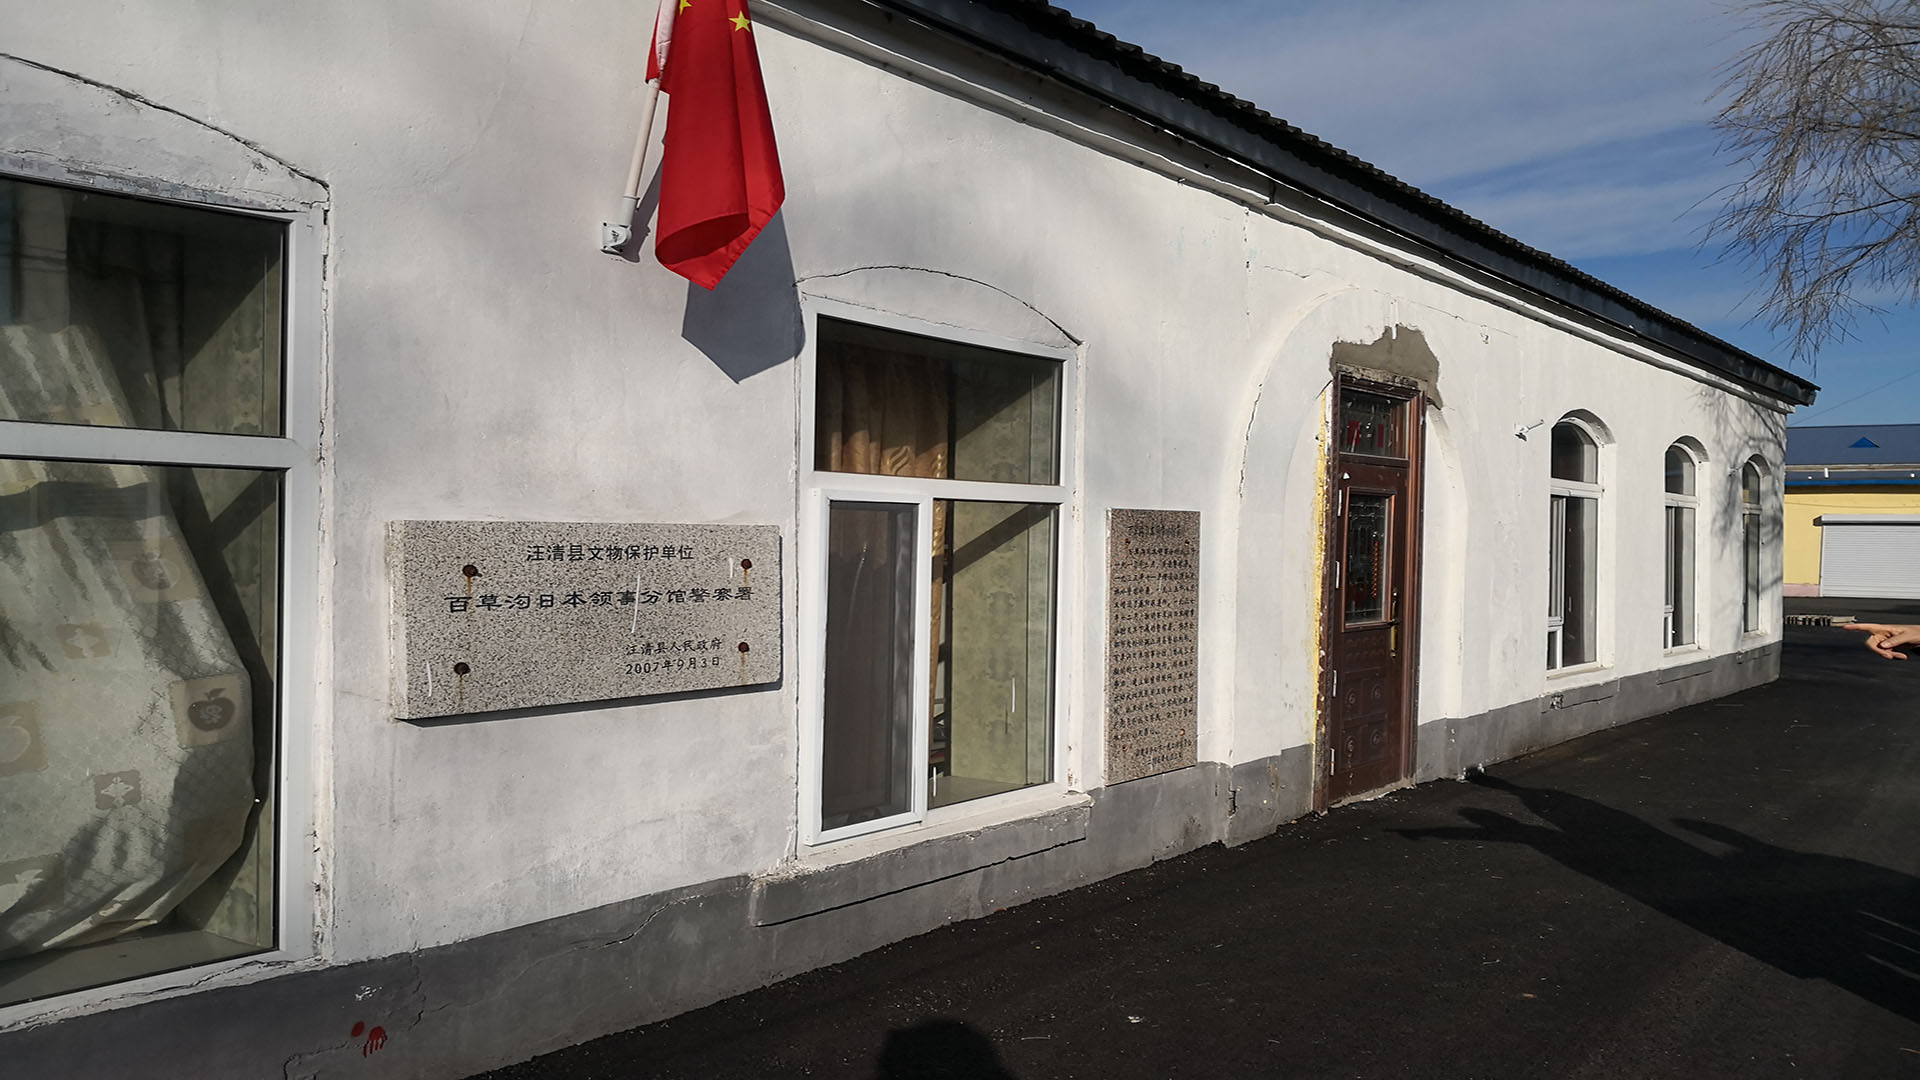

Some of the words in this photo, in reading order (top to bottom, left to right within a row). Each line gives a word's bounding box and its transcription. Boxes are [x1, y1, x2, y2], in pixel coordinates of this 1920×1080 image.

[525, 544, 694, 562] 汪清县文物保护单位
[444, 586, 754, 613] 百草沟日本领事分馆警察署
[625, 638, 723, 656] 汪清县人民政府
[625, 656, 721, 675] 2007年9月3日
